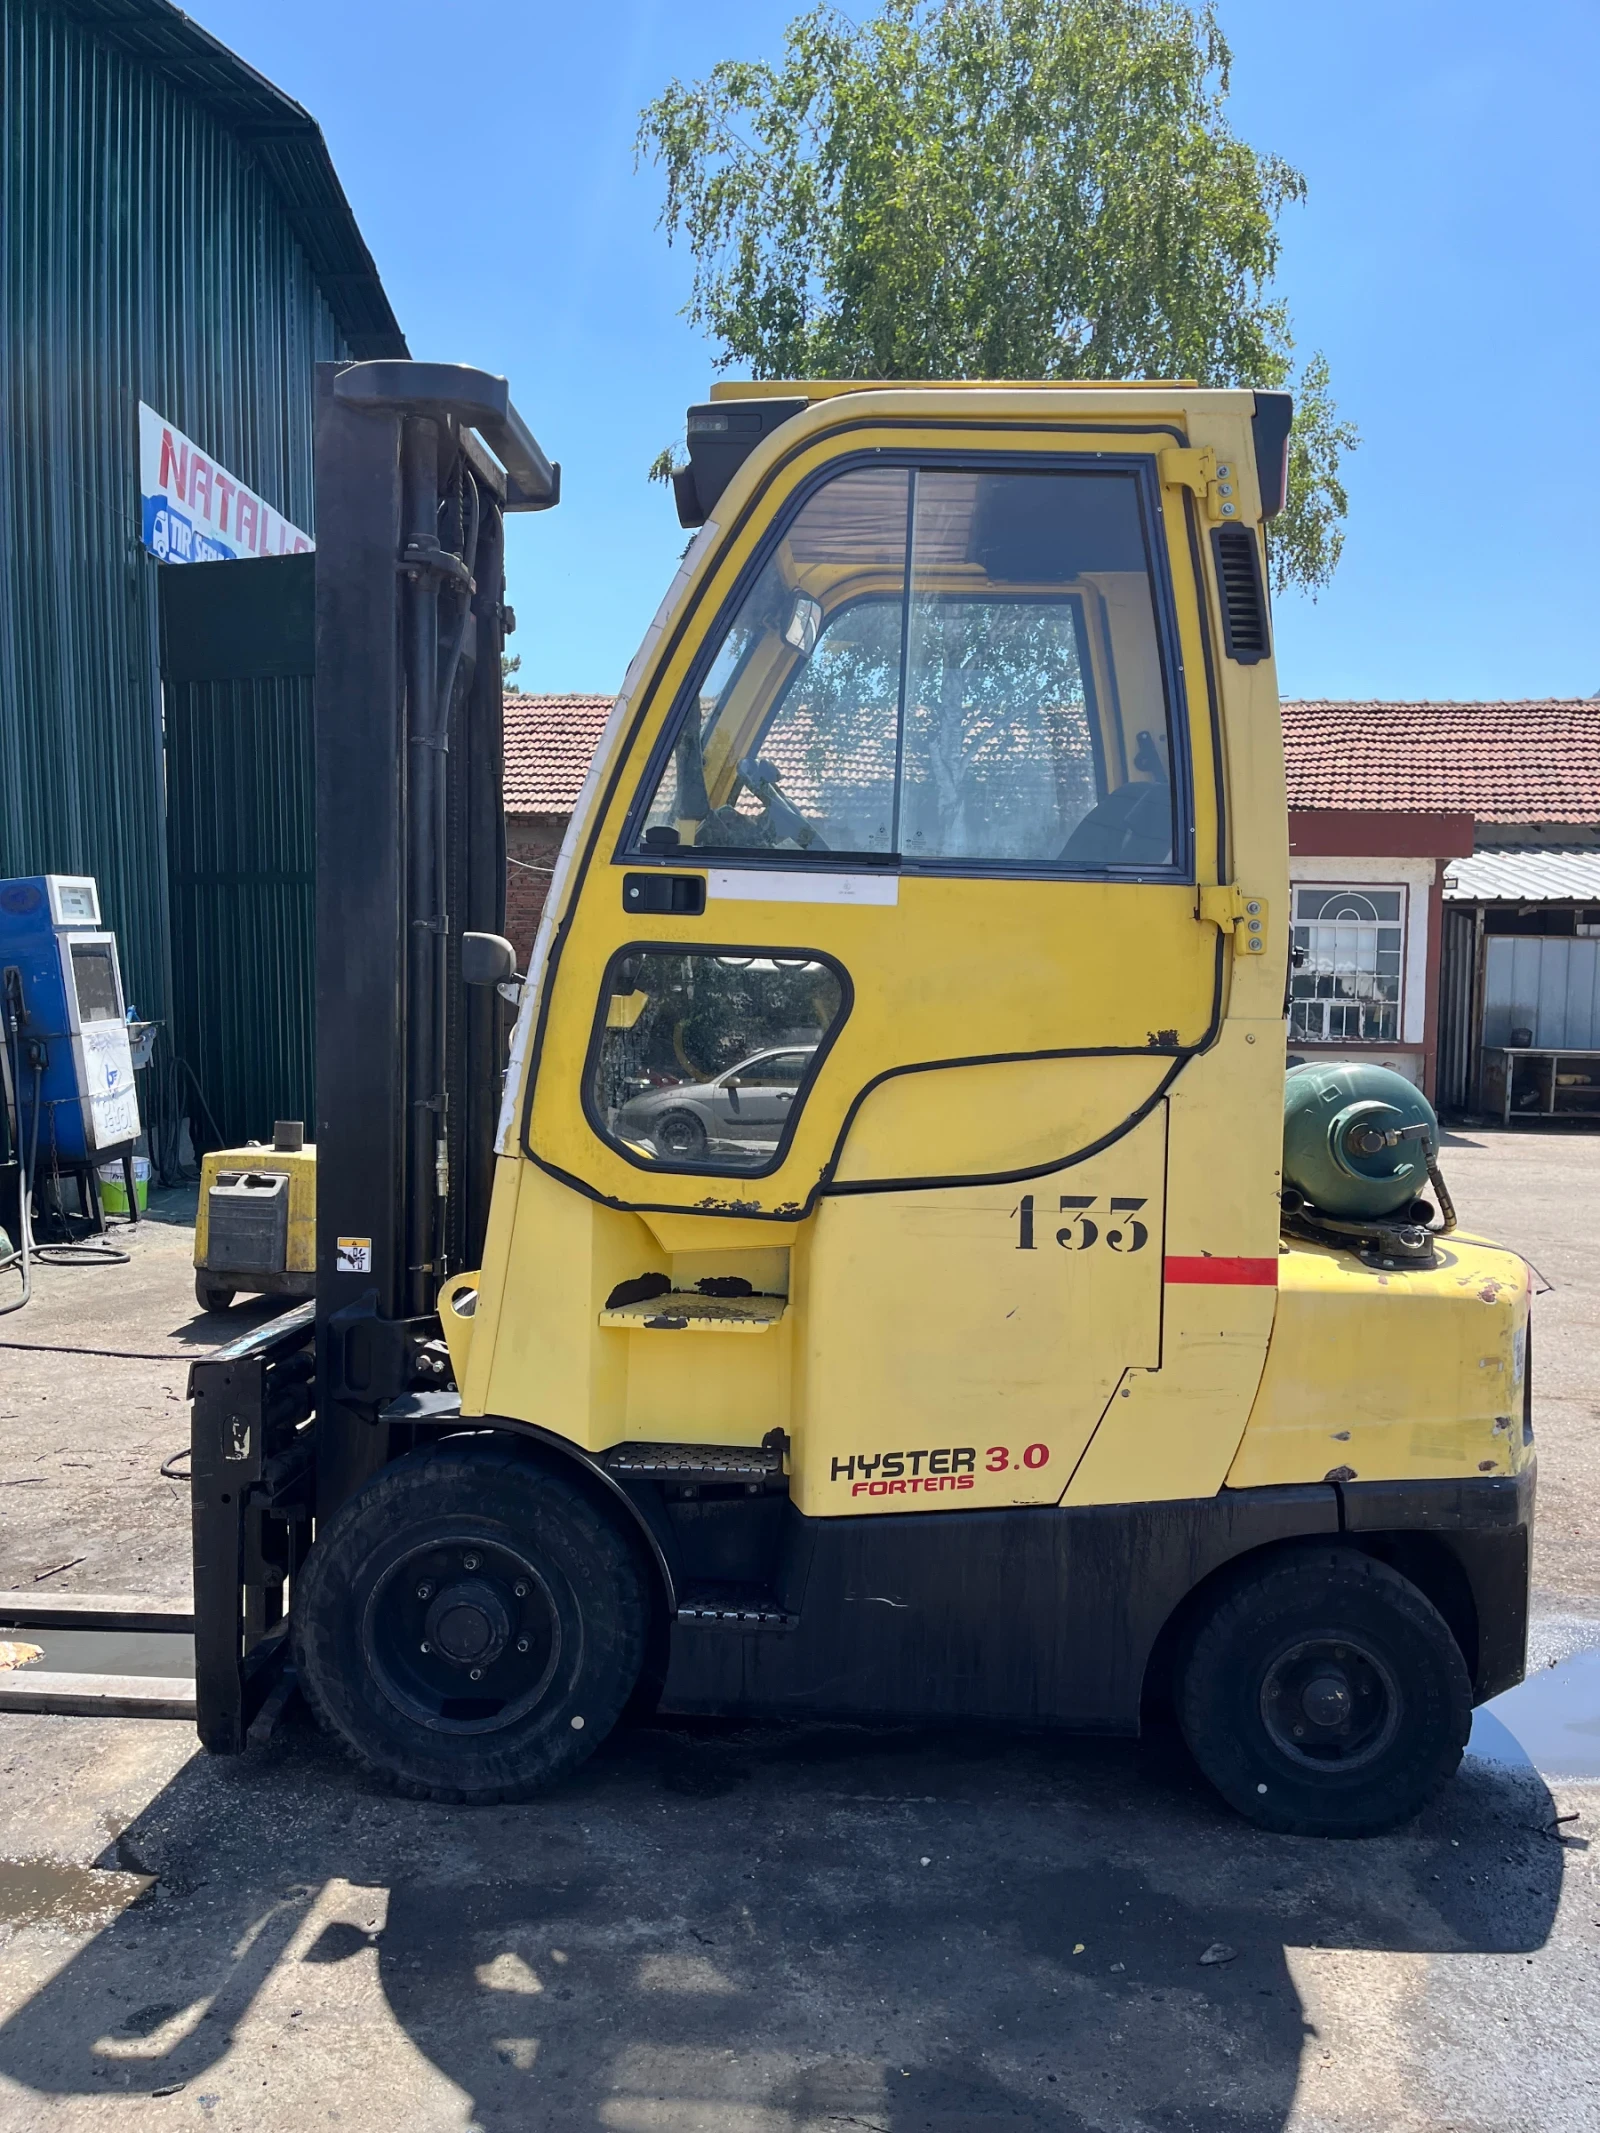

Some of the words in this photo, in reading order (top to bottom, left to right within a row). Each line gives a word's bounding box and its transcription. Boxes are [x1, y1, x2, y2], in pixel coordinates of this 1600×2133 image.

[170, 517, 192, 558] TIR
[1010, 1195, 1149, 1252] 133
[831, 1448, 976, 1481] HYSTER
[985, 1443, 1050, 1472] 3.0
[852, 1474, 975, 1497] FORTENS
